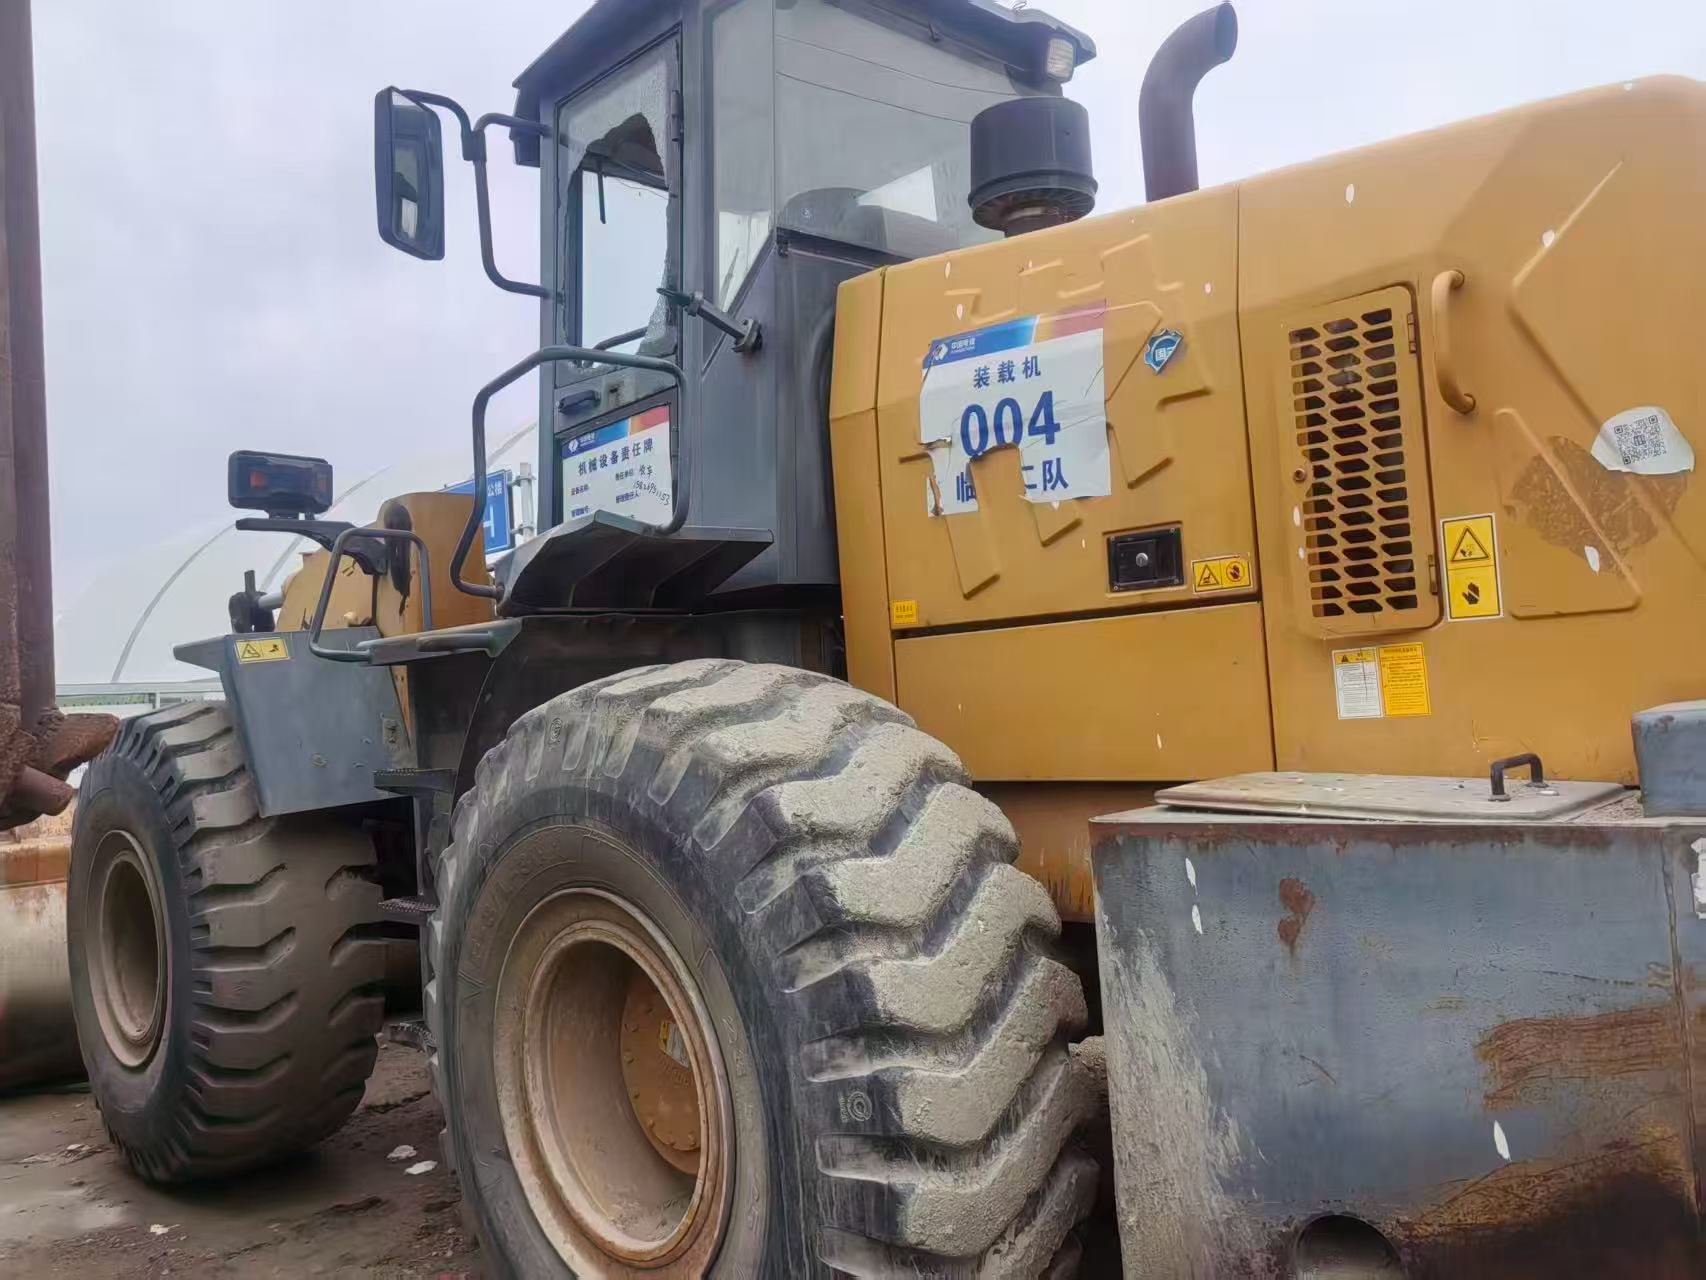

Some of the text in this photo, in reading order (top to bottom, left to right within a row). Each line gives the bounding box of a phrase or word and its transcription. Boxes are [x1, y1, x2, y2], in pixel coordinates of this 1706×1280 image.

[973, 355, 1041, 389] 装载机
[960, 390, 1061, 457] 004
[578, 438, 653, 476] 机械设备责任牌
